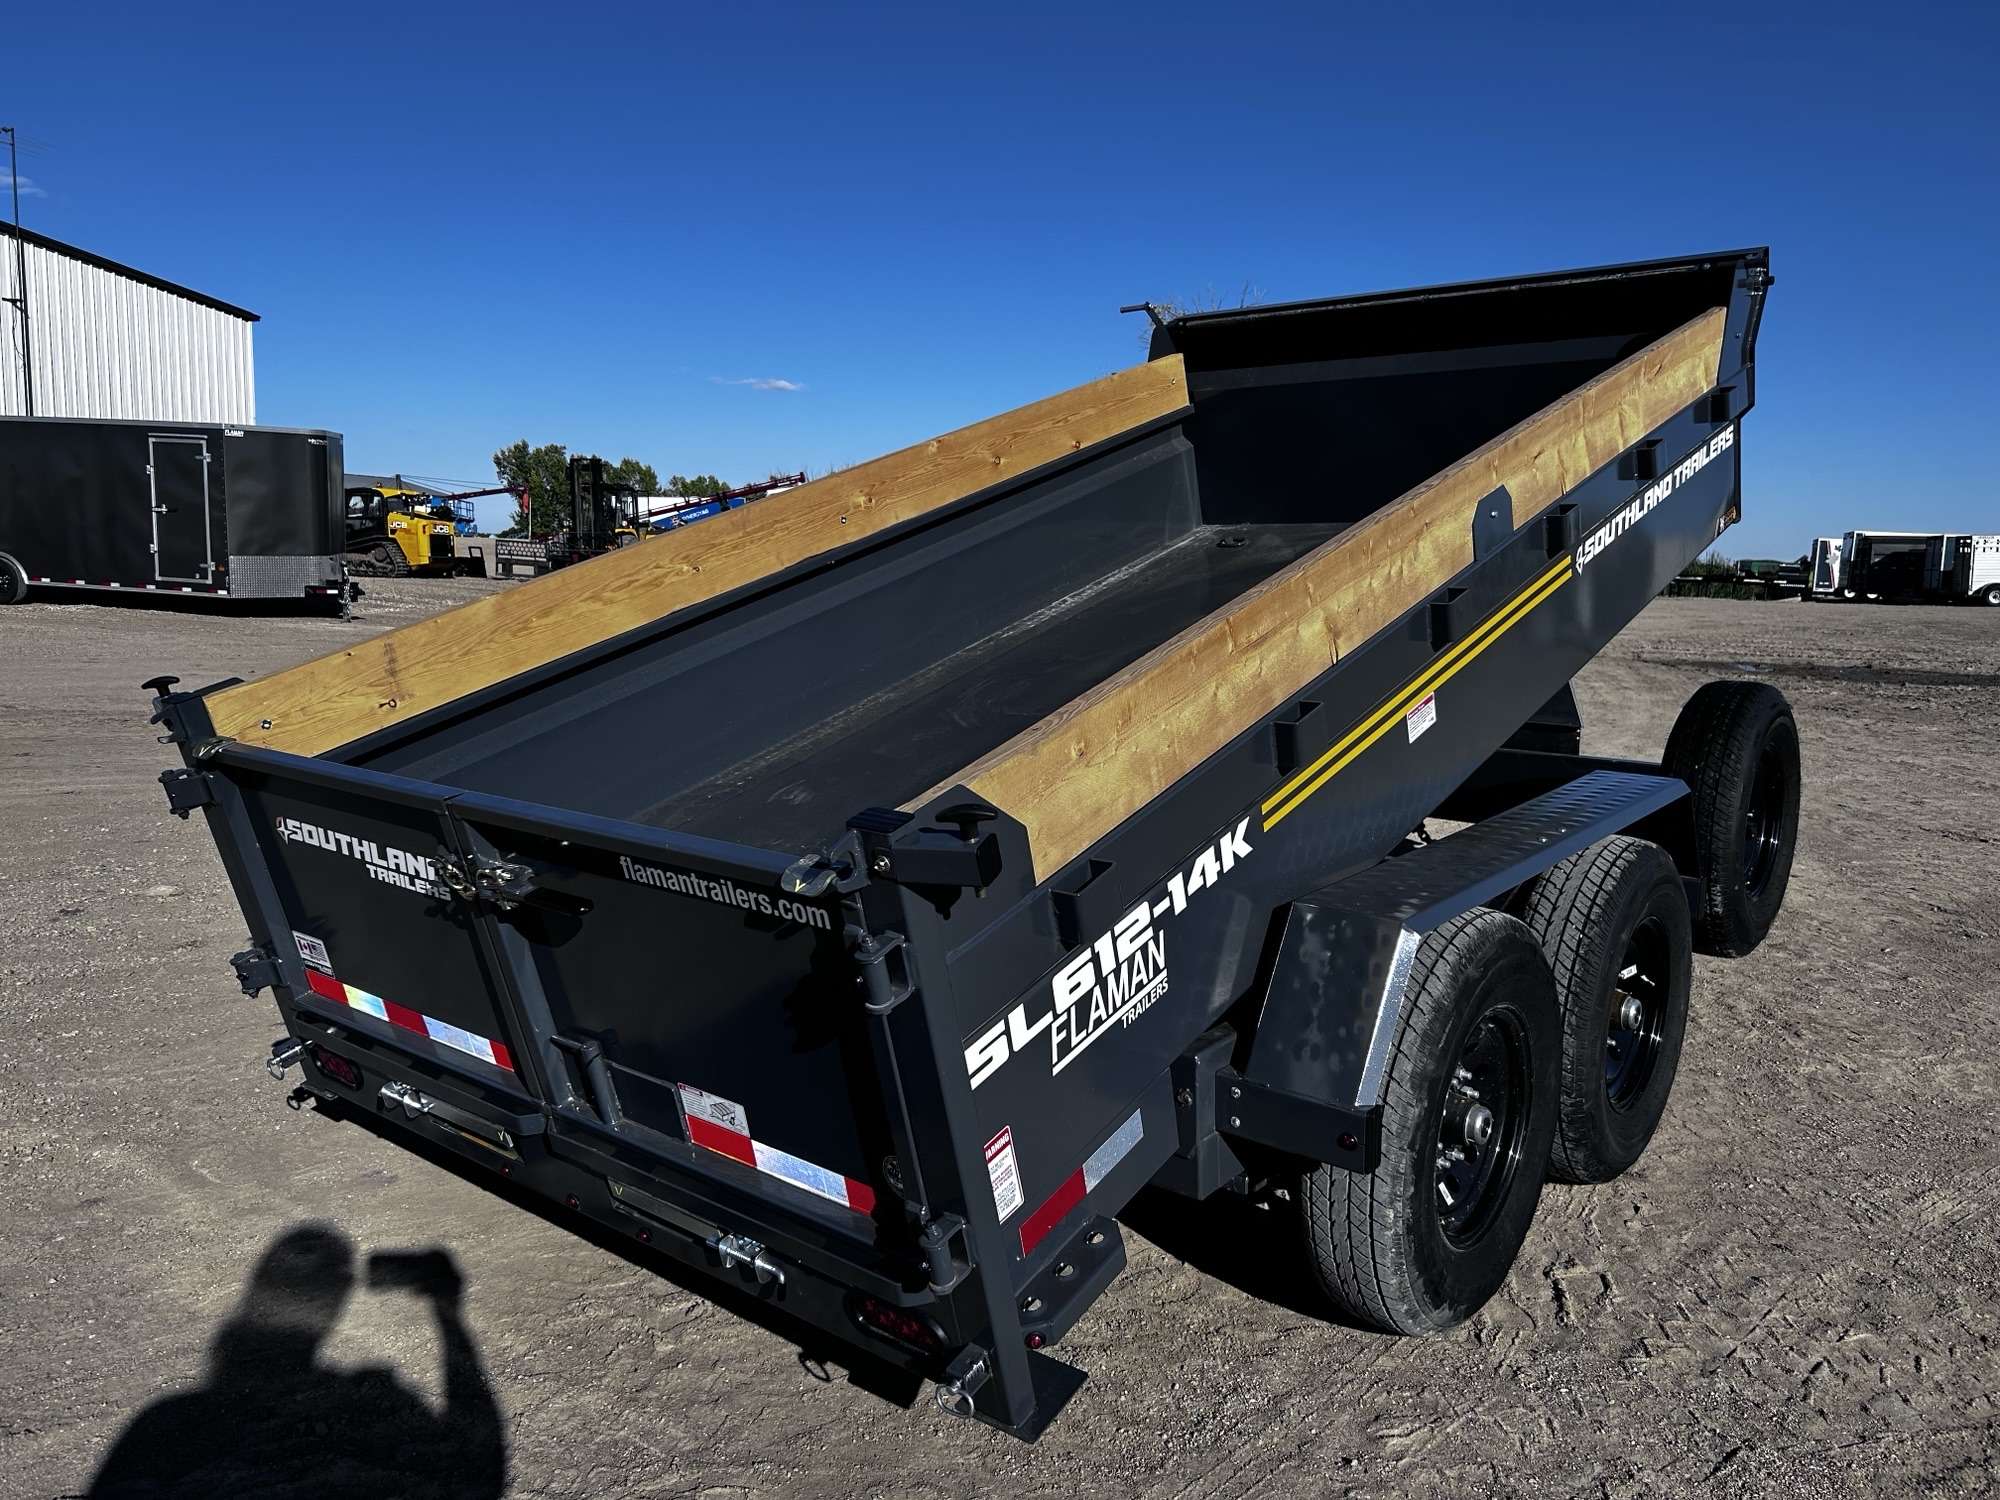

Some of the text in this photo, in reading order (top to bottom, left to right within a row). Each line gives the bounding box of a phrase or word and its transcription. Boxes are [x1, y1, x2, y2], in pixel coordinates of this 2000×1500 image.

[1584, 424, 1734, 564] SOUTHLAND TRAILERS
[390, 521, 408, 529] JCB
[433, 525, 449, 533] JCB
[366, 863, 452, 902] TRAILERS
[619, 855, 832, 930] flamantrailers.com
[1051, 928, 1166, 1065] FLAMAN
[1121, 977, 1169, 1029] TRAILERS
